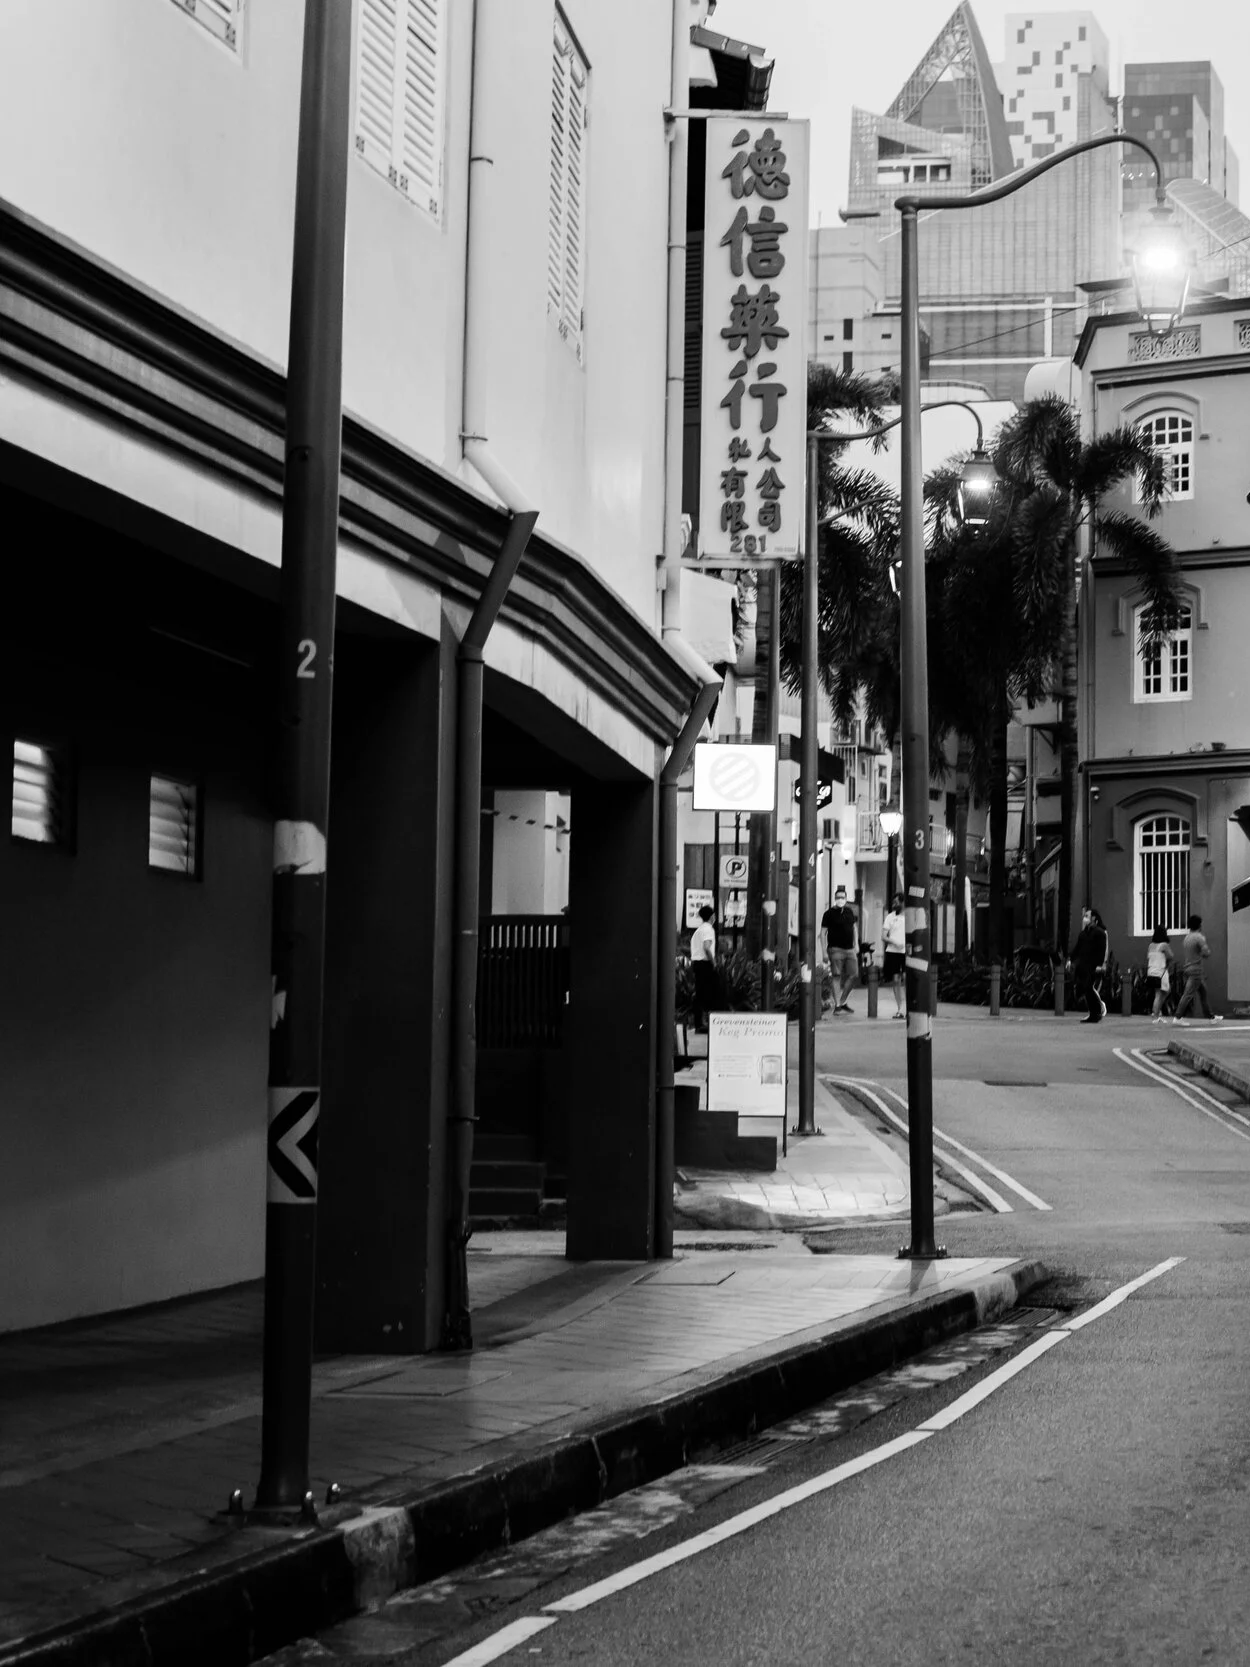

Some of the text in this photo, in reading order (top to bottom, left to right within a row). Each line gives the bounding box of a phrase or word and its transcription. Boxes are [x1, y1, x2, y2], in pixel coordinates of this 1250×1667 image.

[730, 535, 766, 554] 281
[297, 639, 317, 679] 2
[915, 829, 925, 850] 3
[808, 852, 816, 867] 4
[718, 1027, 785, 1039] Keg Promo
